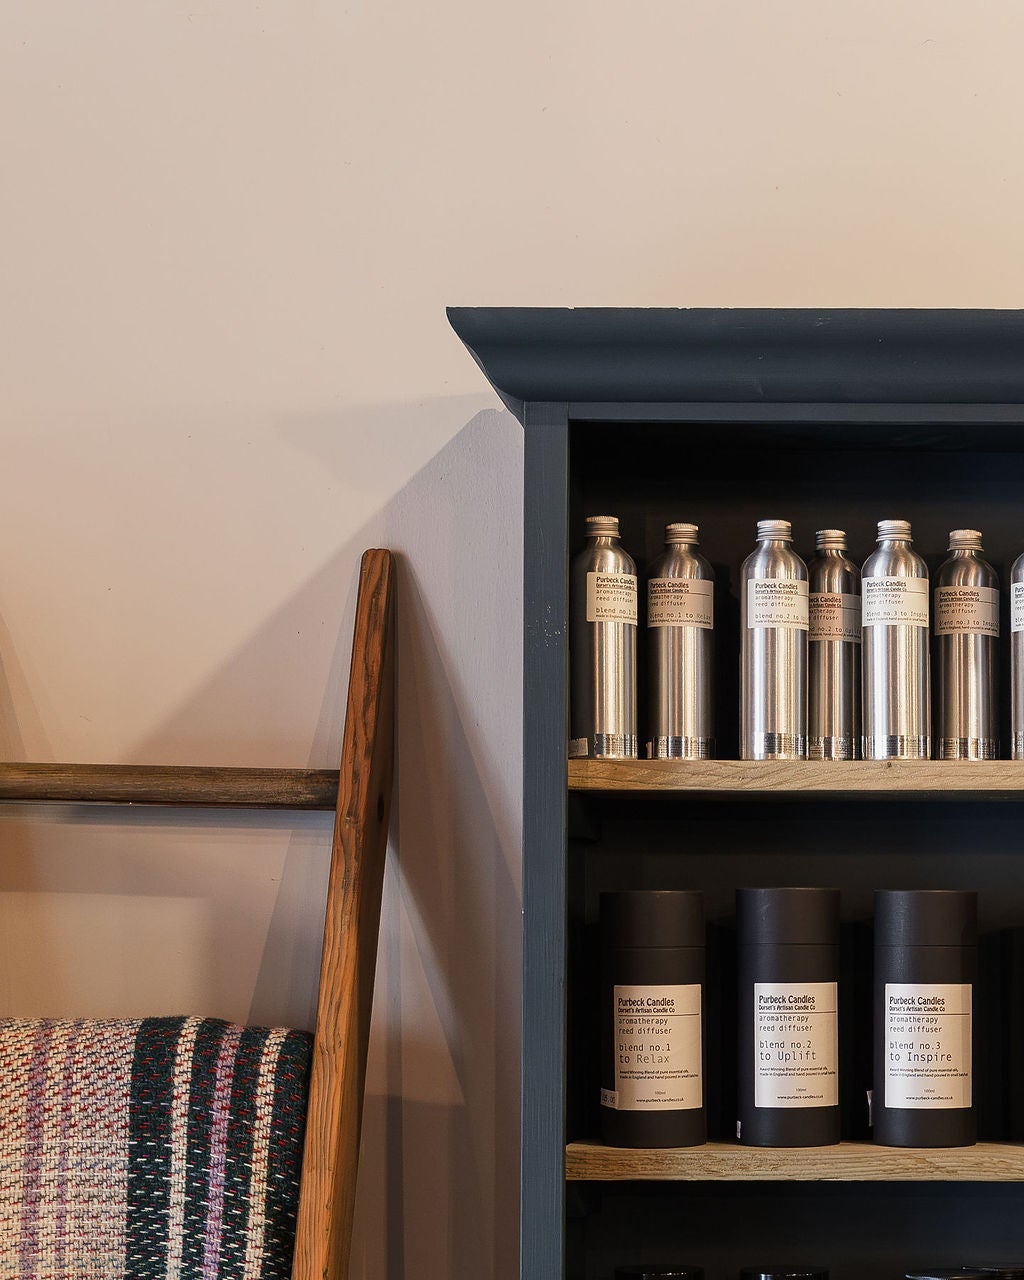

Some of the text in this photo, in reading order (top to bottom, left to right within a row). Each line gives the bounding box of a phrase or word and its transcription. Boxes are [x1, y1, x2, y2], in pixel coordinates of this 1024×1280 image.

[618, 998, 675, 1006] Purbeck Candles
[759, 995, 815, 1004] Purbeck Candles
[889, 996, 945, 1005] Purbeck Candles
[618, 1017, 668, 1025] aromatherapy
[890, 1016, 938, 1024] aromatherapy
[619, 1043, 643, 1051] blend
[759, 1040, 811, 1048] blend no.2
[890, 1041, 941, 1050] blend no.3
[619, 1054, 670, 1064] to Relax
[760, 1051, 816, 1062] to Uplift
[890, 1052, 952, 1063] to Inspire
